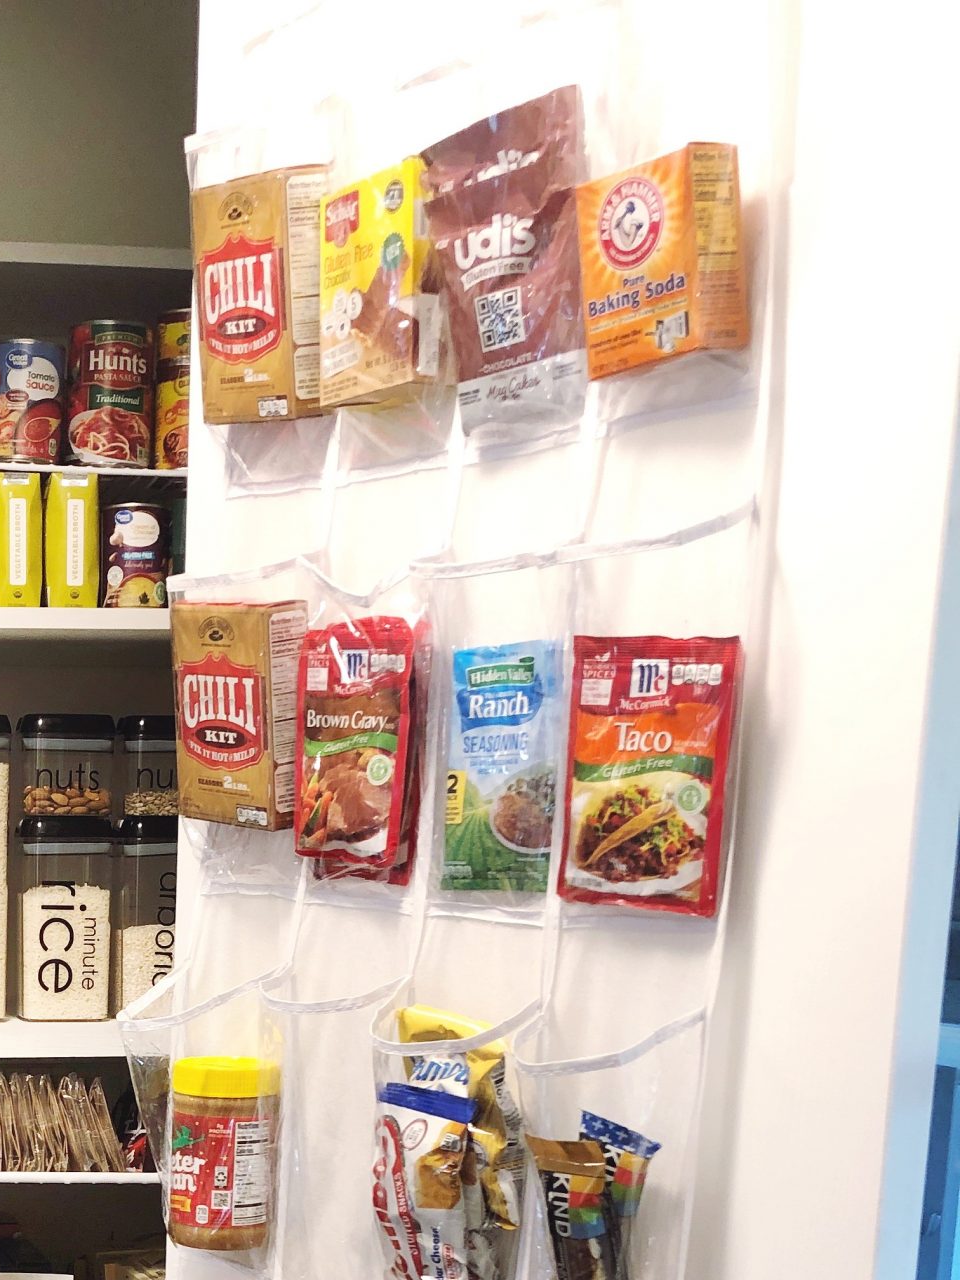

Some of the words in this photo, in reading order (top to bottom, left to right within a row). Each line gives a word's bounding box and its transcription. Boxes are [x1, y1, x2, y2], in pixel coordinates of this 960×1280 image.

[454, 213, 536, 270] udi's
[204, 252, 275, 325] CHILI
[623, 274, 645, 289] Pure
[588, 289, 640, 318] Baking
[645, 273, 686, 299] Soda
[224, 318, 257, 335] KIT
[26, 379, 55, 391] Sauce
[28, 371, 55, 383] Tomato
[94, 373, 118, 382] PASTA
[95, 393, 140, 405] Traditional
[470, 671, 507, 686] Hidden
[507, 668, 534, 683] Valley
[183, 674, 257, 736] CHILI
[468, 691, 530, 719] Ranch
[619, 696, 673, 711] McCormick
[306, 709, 350, 729] Brown
[351, 710, 389, 735] Gravy
[204, 729, 238, 745] KIT
[463, 731, 529, 754] SEASONING
[614, 722, 673, 752] Taco
[36, 763, 101, 791] nuts
[602, 758, 674, 779] Gluten-Free
[223, 775, 233, 789] 2
[447, 773, 458, 794] 2
[37, 879, 88, 994] rice
[81, 916, 101, 992] minute
[171, 1151, 206, 1174] eter
[171, 1173, 197, 1193] an
[394, 1171, 409, 1212] SNACKS
[548, 1172, 572, 1238] KIND
